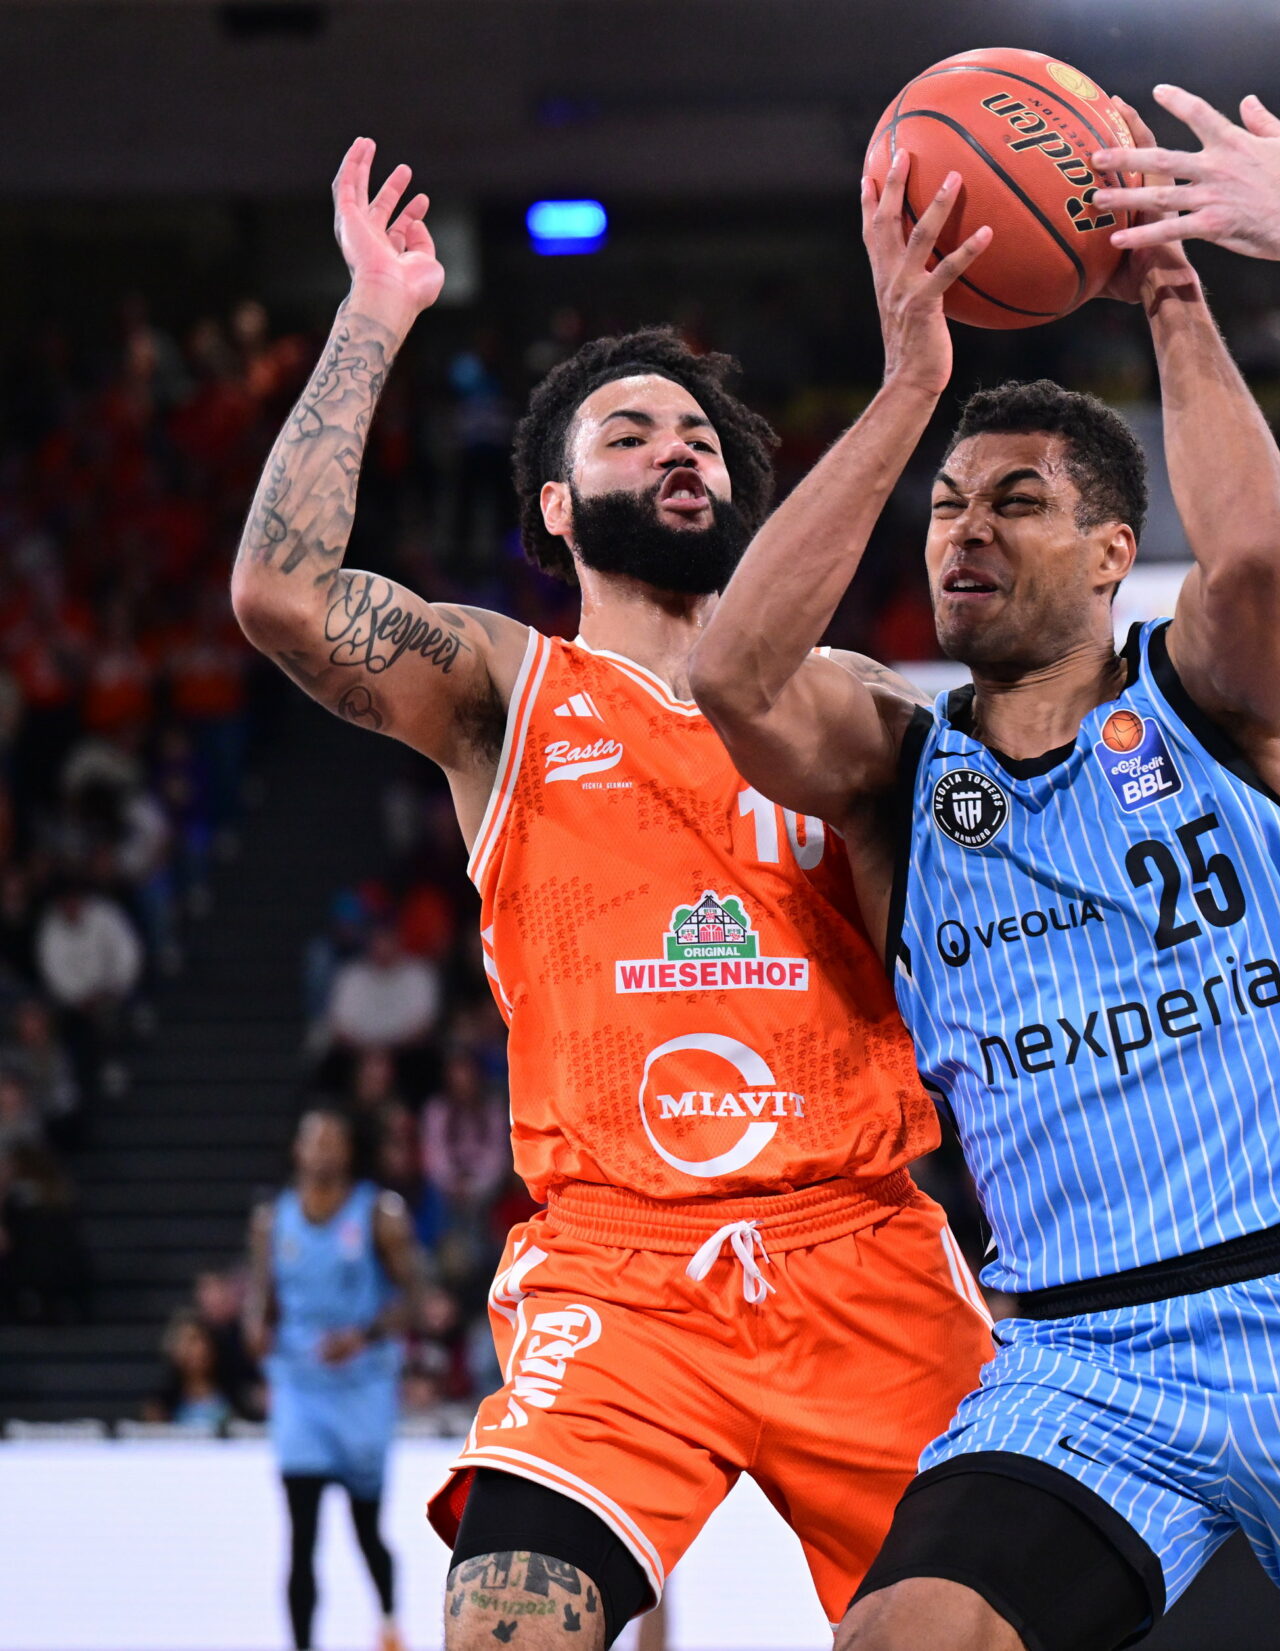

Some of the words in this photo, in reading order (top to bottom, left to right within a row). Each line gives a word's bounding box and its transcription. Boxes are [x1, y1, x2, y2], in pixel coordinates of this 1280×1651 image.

[981, 93, 1116, 232] Baden
[325, 573, 471, 674] Respect
[544, 738, 623, 769] Rasta
[935, 773, 962, 810] VEOLIA
[967, 773, 1004, 806] TOWERS
[1122, 769, 1173, 804] BBL
[1124, 813, 1246, 951] 25
[974, 900, 1105, 948] VEOLIA
[684, 946, 741, 958] ORIGINAL
[620, 962, 804, 990] WIESENHOF
[656, 1091, 806, 1119] MIAVIT
